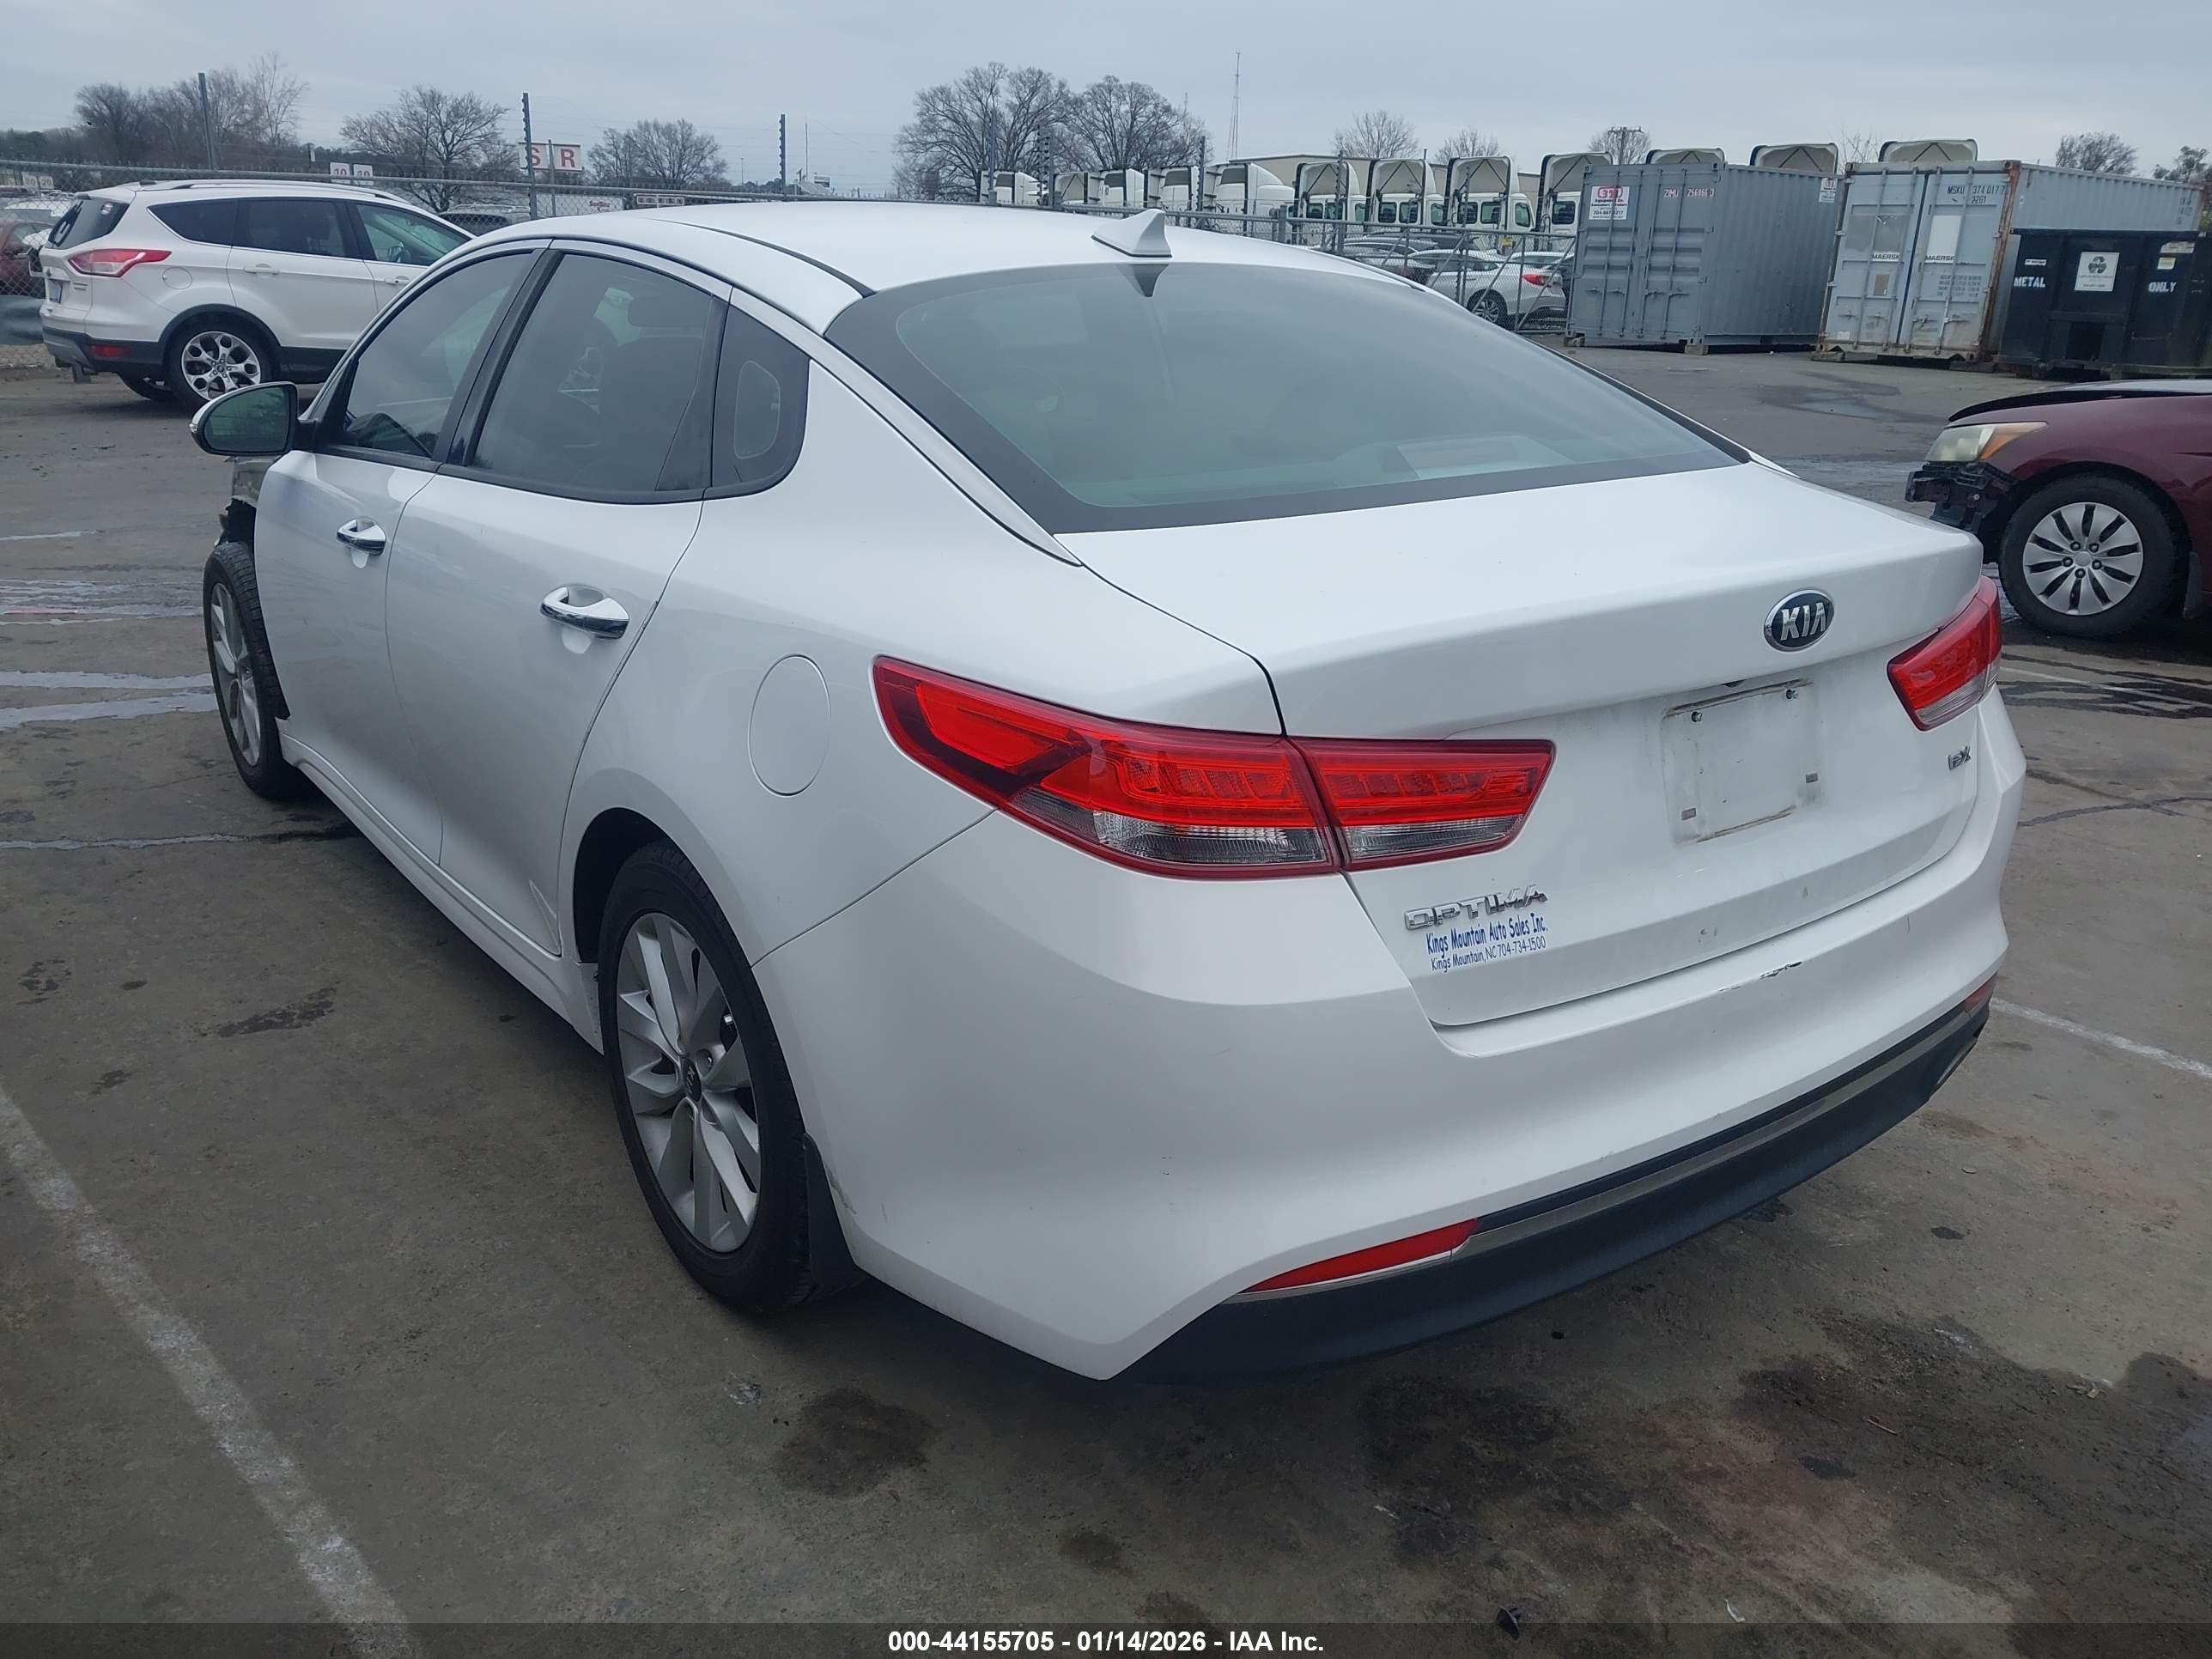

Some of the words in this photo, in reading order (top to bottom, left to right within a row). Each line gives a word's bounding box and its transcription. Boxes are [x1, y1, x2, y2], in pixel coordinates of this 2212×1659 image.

[561, 149, 576, 168] R
[1947, 185, 1966, 194] MSKU
[1972, 185, 1985, 195] 374
[2013, 276, 2046, 289] METAL
[2148, 281, 2178, 293] ONLY
[1780, 602, 1826, 641] KIA
[1947, 744, 1972, 770] EX
[1404, 884, 1548, 931] OPTIMA
[1425, 932, 1449, 959] Kings
[1450, 923, 1487, 951] Mountain
[1488, 920, 1508, 942] Auto
[1509, 914, 1530, 939] Sales
[1530, 912, 1549, 935] Inc.
[1431, 956, 1452, 974] Kings
[1485, 945, 1497, 960] NC
[1498, 935, 1547, 957] 704-734-1500
